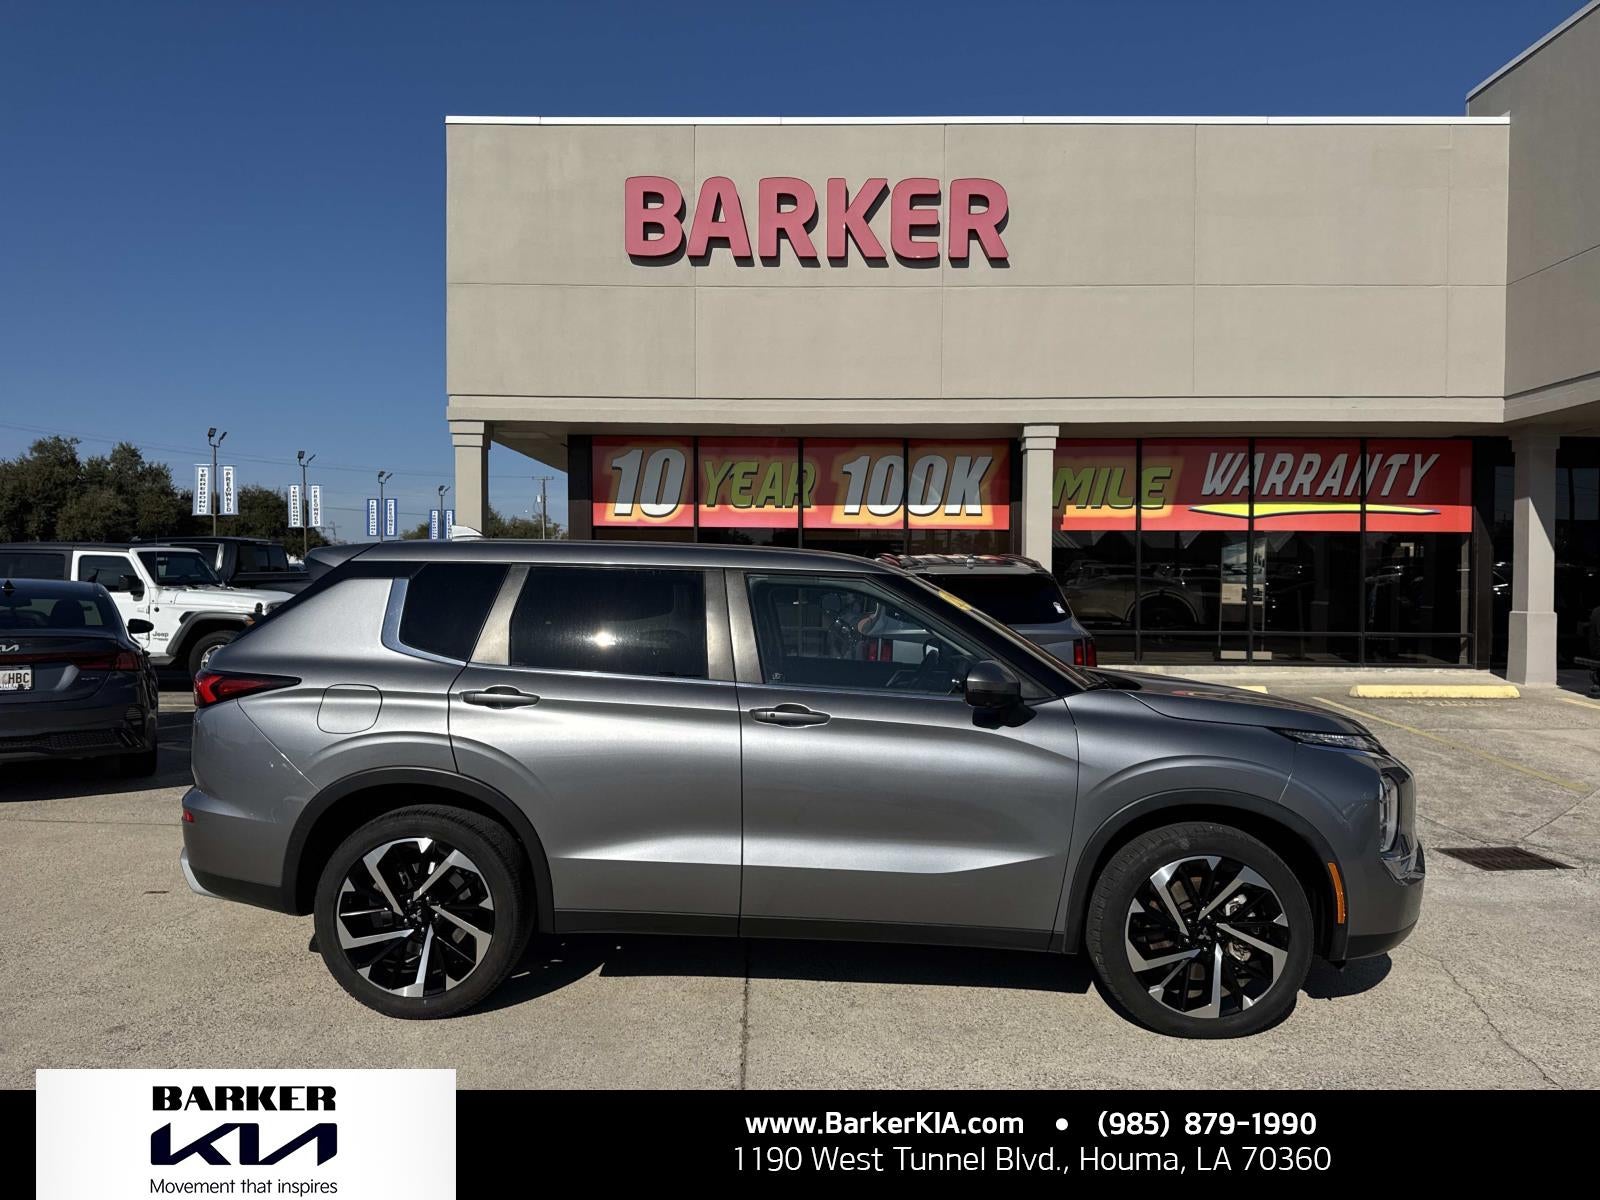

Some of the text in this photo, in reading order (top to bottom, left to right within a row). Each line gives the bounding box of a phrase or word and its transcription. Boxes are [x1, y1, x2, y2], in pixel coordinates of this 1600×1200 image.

[624, 175, 1010, 261] BARKER
[198, 468, 207, 513] TERREBONNE
[225, 471, 233, 513] PREOWNED
[611, 447, 1441, 518] 10 YEAR 100K MILE WARRANTY
[152, 630, 169, 638] Jeep
[8, 672, 30, 684] HBC
